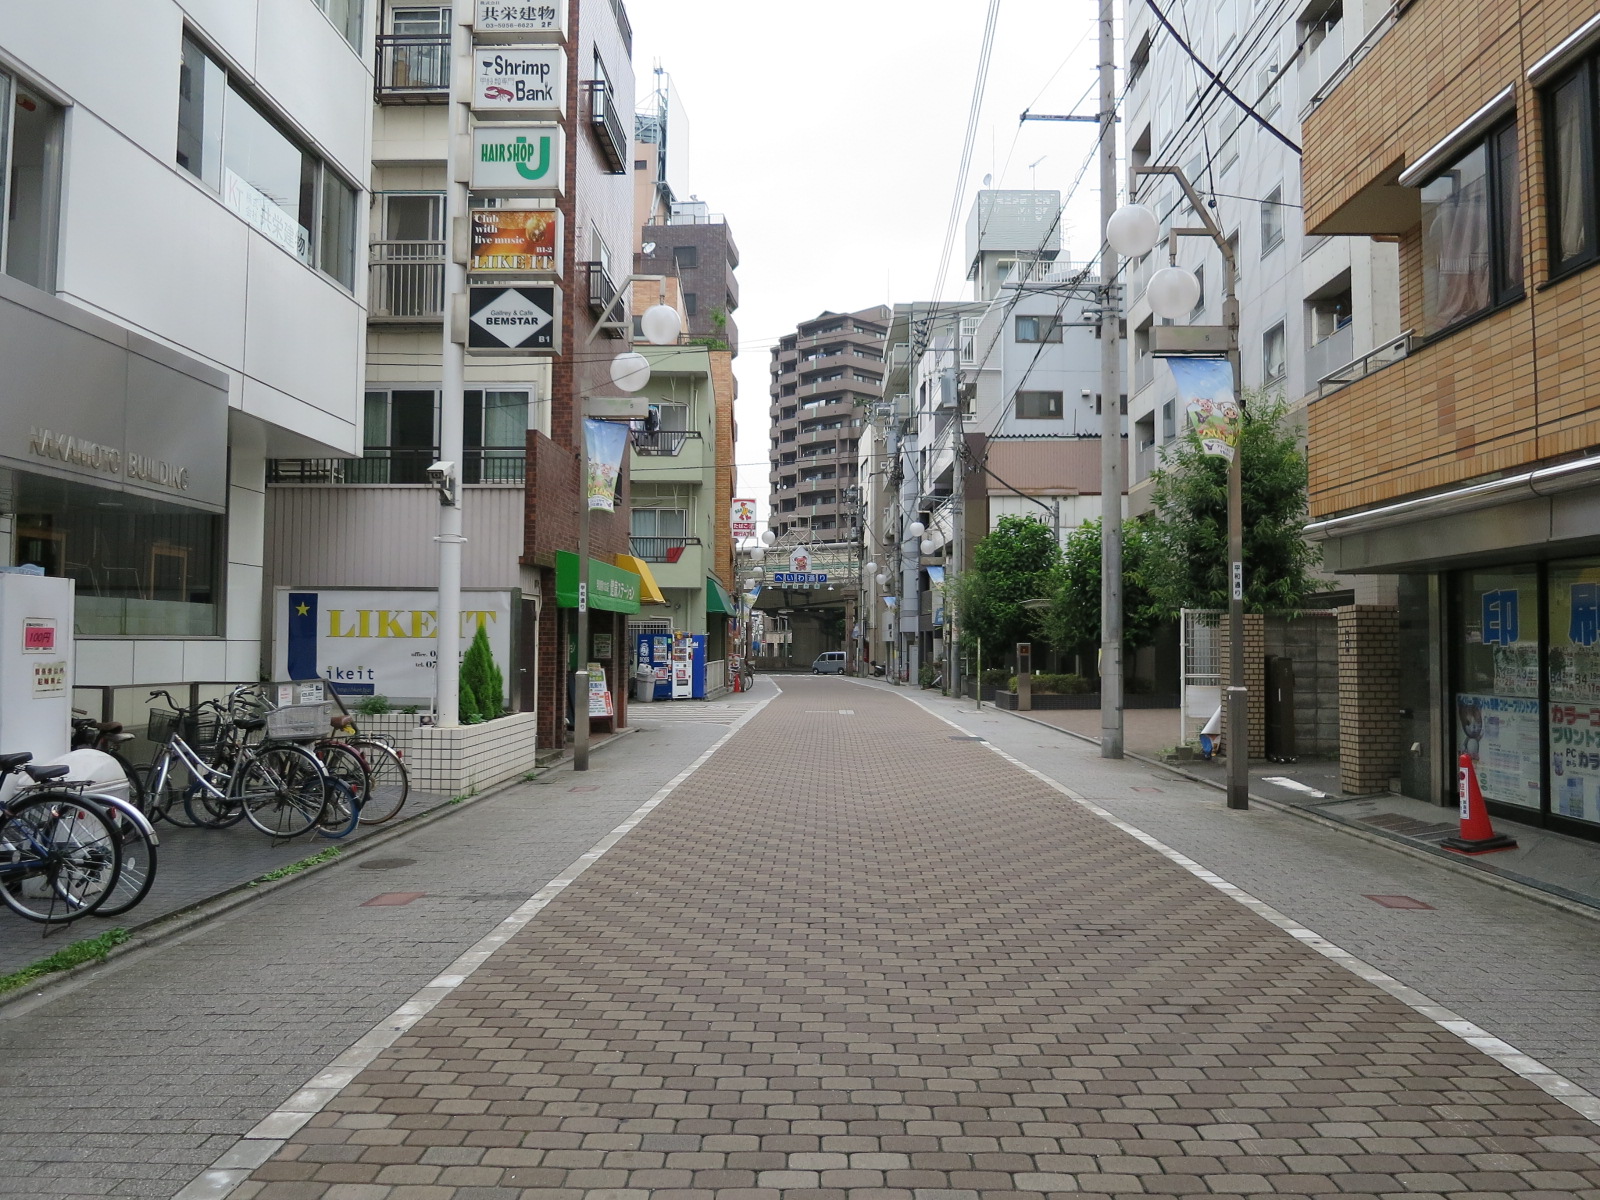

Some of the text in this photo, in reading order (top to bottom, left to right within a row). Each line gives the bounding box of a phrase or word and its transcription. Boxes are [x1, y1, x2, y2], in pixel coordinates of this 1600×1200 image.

[482, 6, 556, 21] 共栄建物
[494, 55, 551, 83] Shrimp
[515, 80, 553, 101] Bank
[481, 143, 535, 162] HAIR SHOP
[474, 214, 499, 223] Club
[261, 205, 306, 257] 共栄建物
[475, 225, 498, 233] with
[474, 236, 525, 244] live music
[472, 255, 554, 270] LIKE IT
[486, 317, 539, 326] BEMSTAR
[538, 335, 550, 343] B1
[29, 425, 190, 491] NAKAMOTO BUILDING
[775, 573, 827, 582] へいわ通り
[1233, 564, 1241, 597] 平和通り
[325, 609, 496, 638] LIKE T
[1482, 588, 1519, 647] 印
[30, 632, 51, 643] 100円
[1566, 748, 1577, 758] PC
